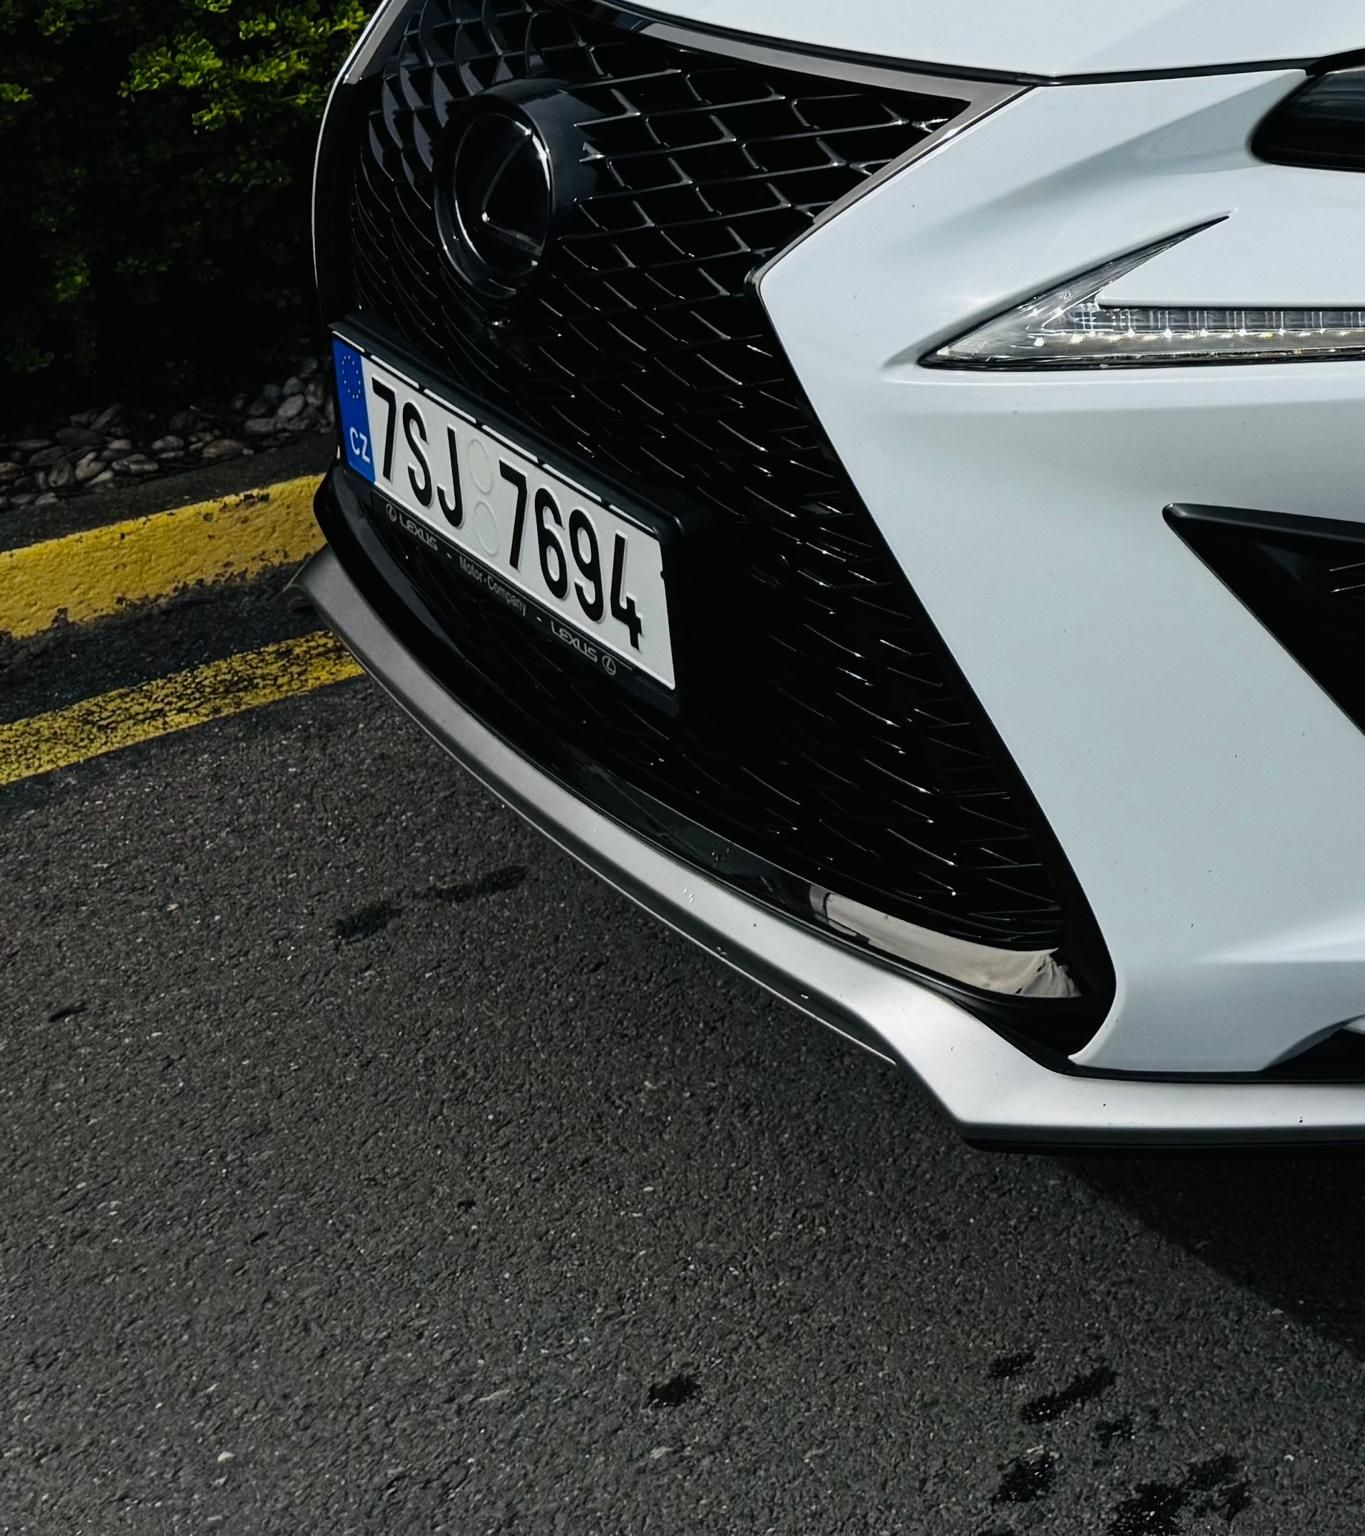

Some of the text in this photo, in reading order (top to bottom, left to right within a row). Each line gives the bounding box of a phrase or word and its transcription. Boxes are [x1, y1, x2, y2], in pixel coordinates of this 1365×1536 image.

[350, 426, 371, 463] CZ
[371, 376, 643, 651] 7SJ 7694
[399, 513, 439, 552] LEXUS
[551, 620, 598, 663] LEXUS
